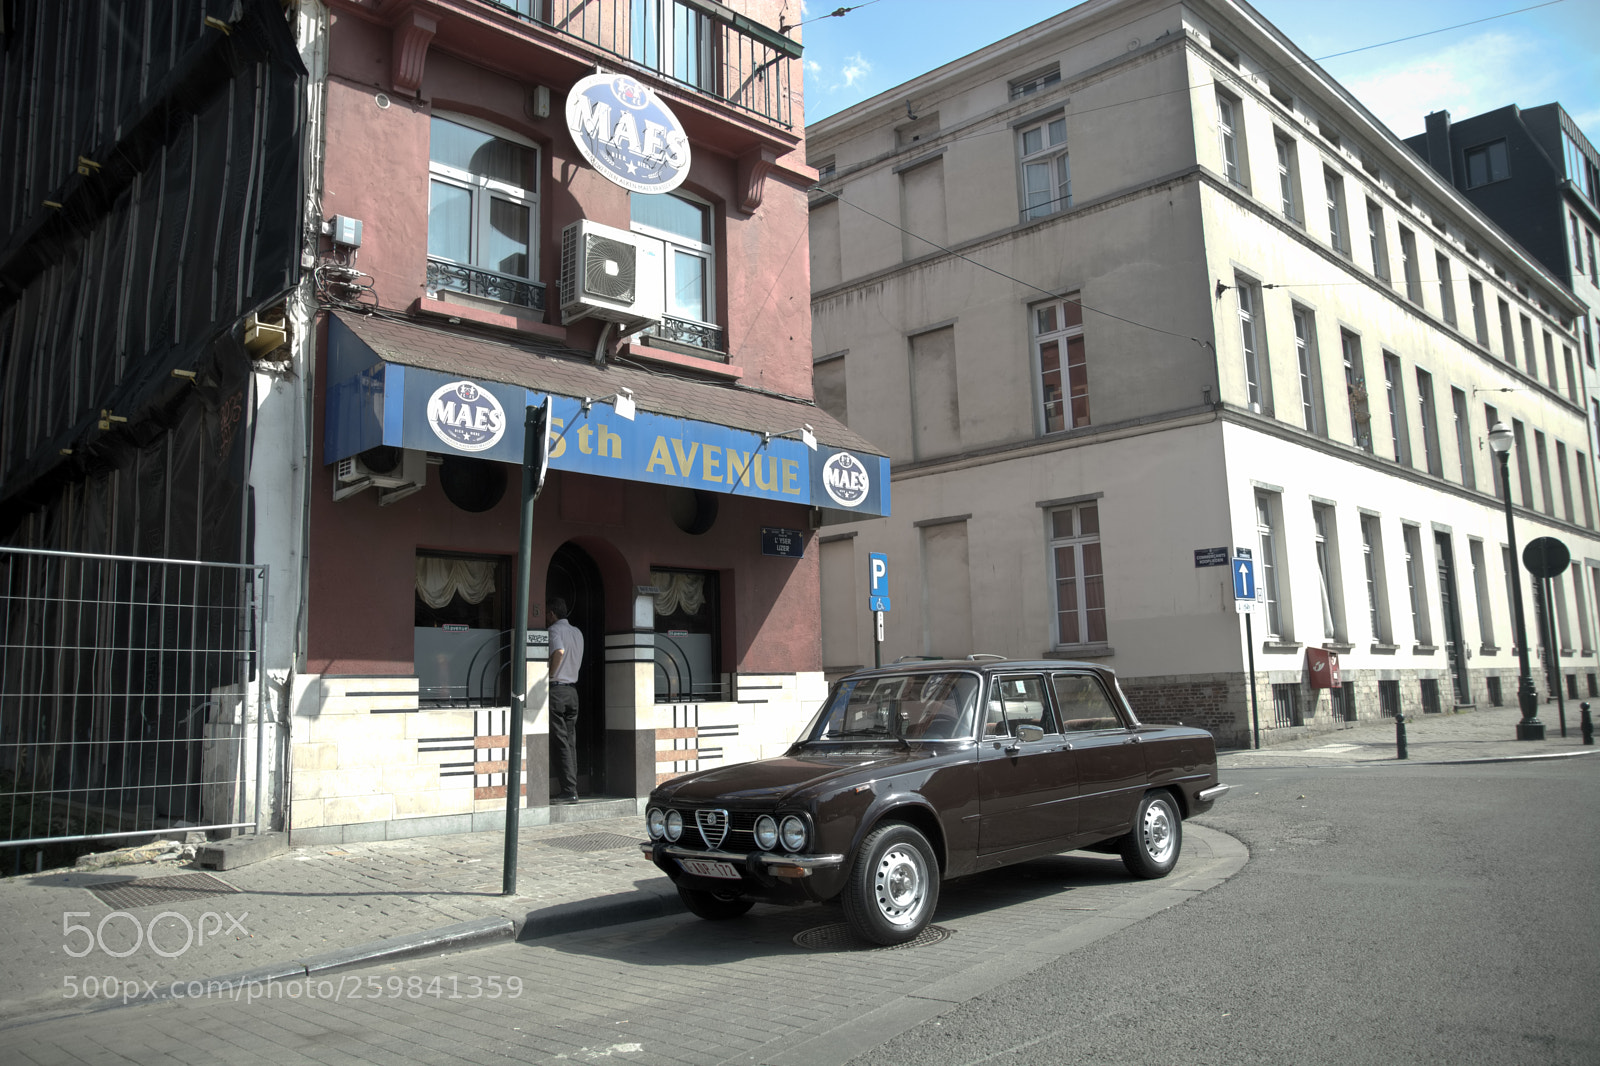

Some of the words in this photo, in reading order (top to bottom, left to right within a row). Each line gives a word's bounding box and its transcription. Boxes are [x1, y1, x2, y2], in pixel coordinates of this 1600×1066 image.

[569, 94, 688, 170] MAES
[428, 399, 502, 433] MAES
[548, 417, 622, 459] 5th
[645, 435, 801, 495] AVENUE
[826, 467, 867, 492] MAES
[872, 559, 886, 590] P
